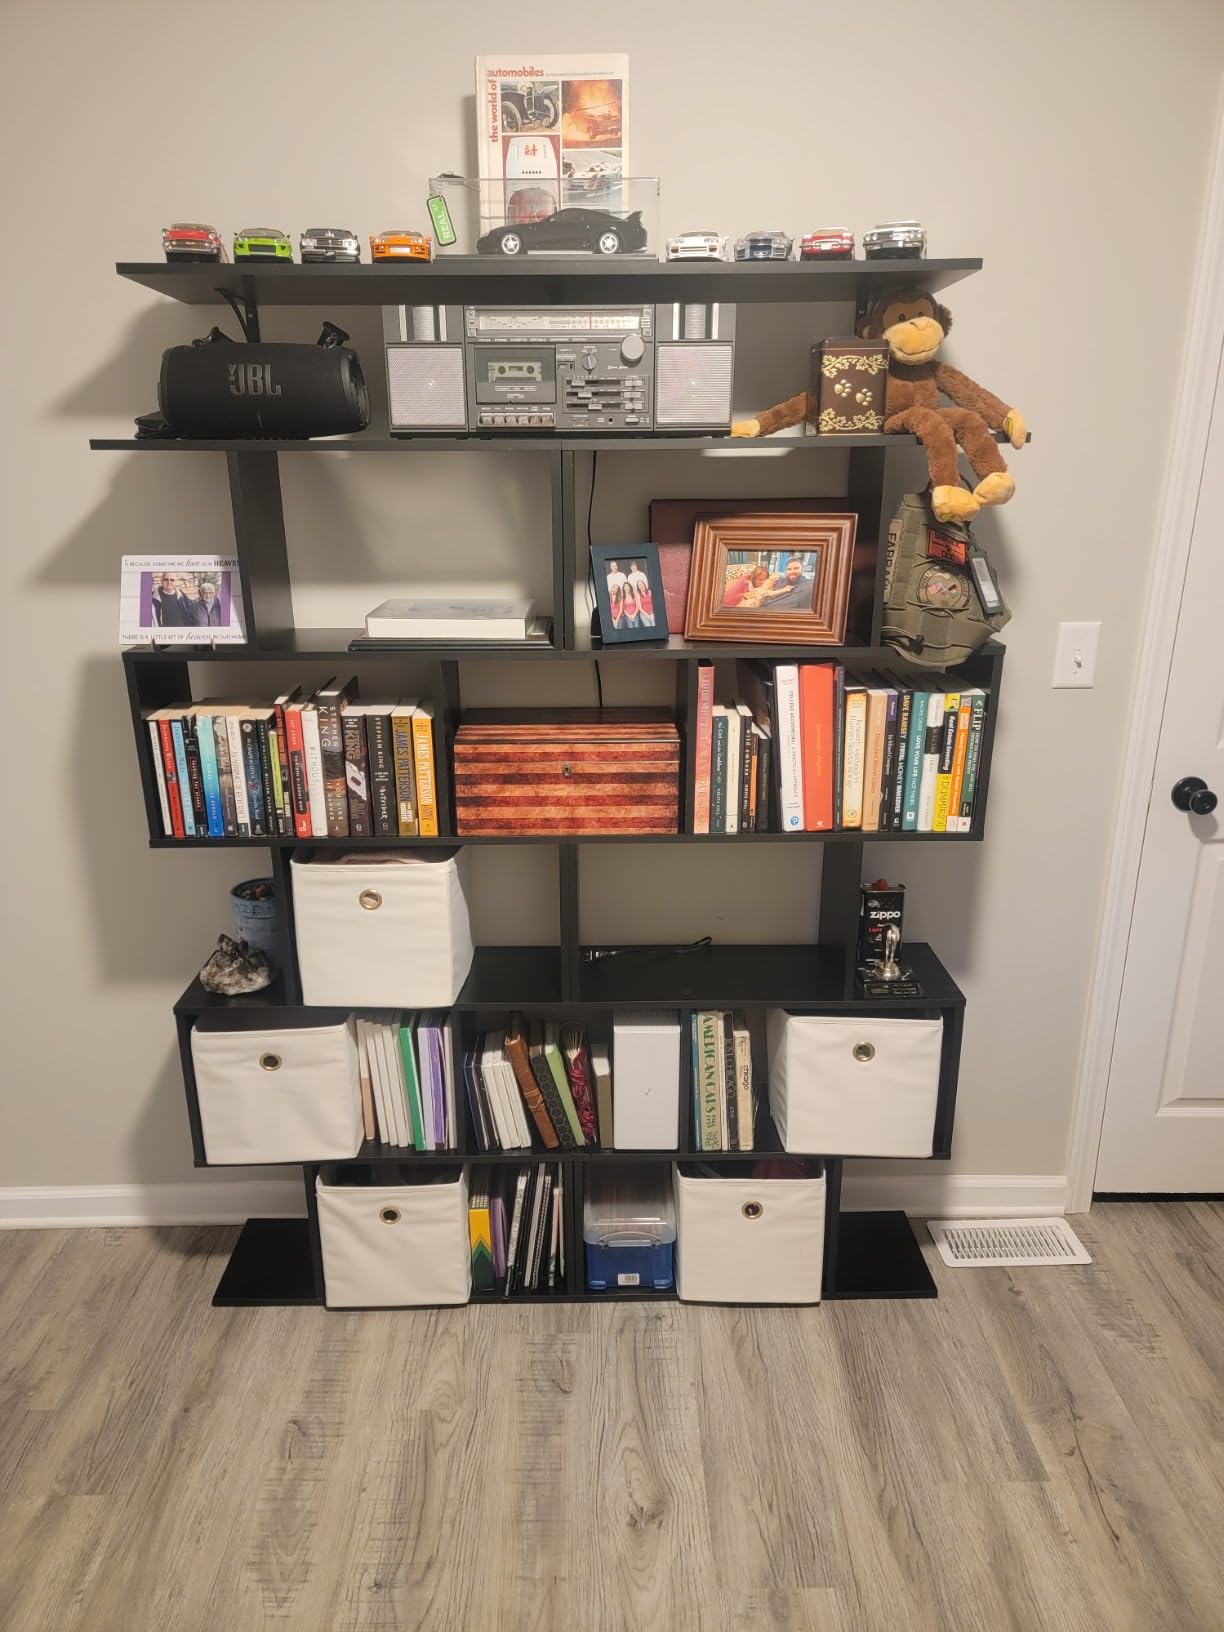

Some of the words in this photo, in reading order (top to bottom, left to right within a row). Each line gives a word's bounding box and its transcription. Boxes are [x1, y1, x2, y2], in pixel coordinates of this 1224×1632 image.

[488, 67, 544, 77] automobiles
[490, 79, 497, 91] of
[488, 93, 498, 124] world
[230, 363, 281, 396] JBL
[902, 695, 910, 711] DAVE
[319, 706, 329, 748] KING
[330, 706, 338, 747] STEPHEN
[900, 712, 909, 739] RAMSEY
[972, 708, 983, 731] FLIP
[345, 730, 354, 760] KING
[395, 729, 410, 756] JAMES
[416, 734, 430, 759] JAMES
[943, 746, 952, 770] Investing
[398, 758, 411, 802] PATTERSON
[418, 762, 432, 804] PATTERSON
[896, 762, 904, 785] MONEY
[895, 785, 903, 813] MAKEOVER
[938, 781, 949, 819] DUMMIES
[870, 911, 901, 920] zippo
[703, 1015, 716, 1080] AMERICAN
[705, 1082, 717, 1113] CARS
